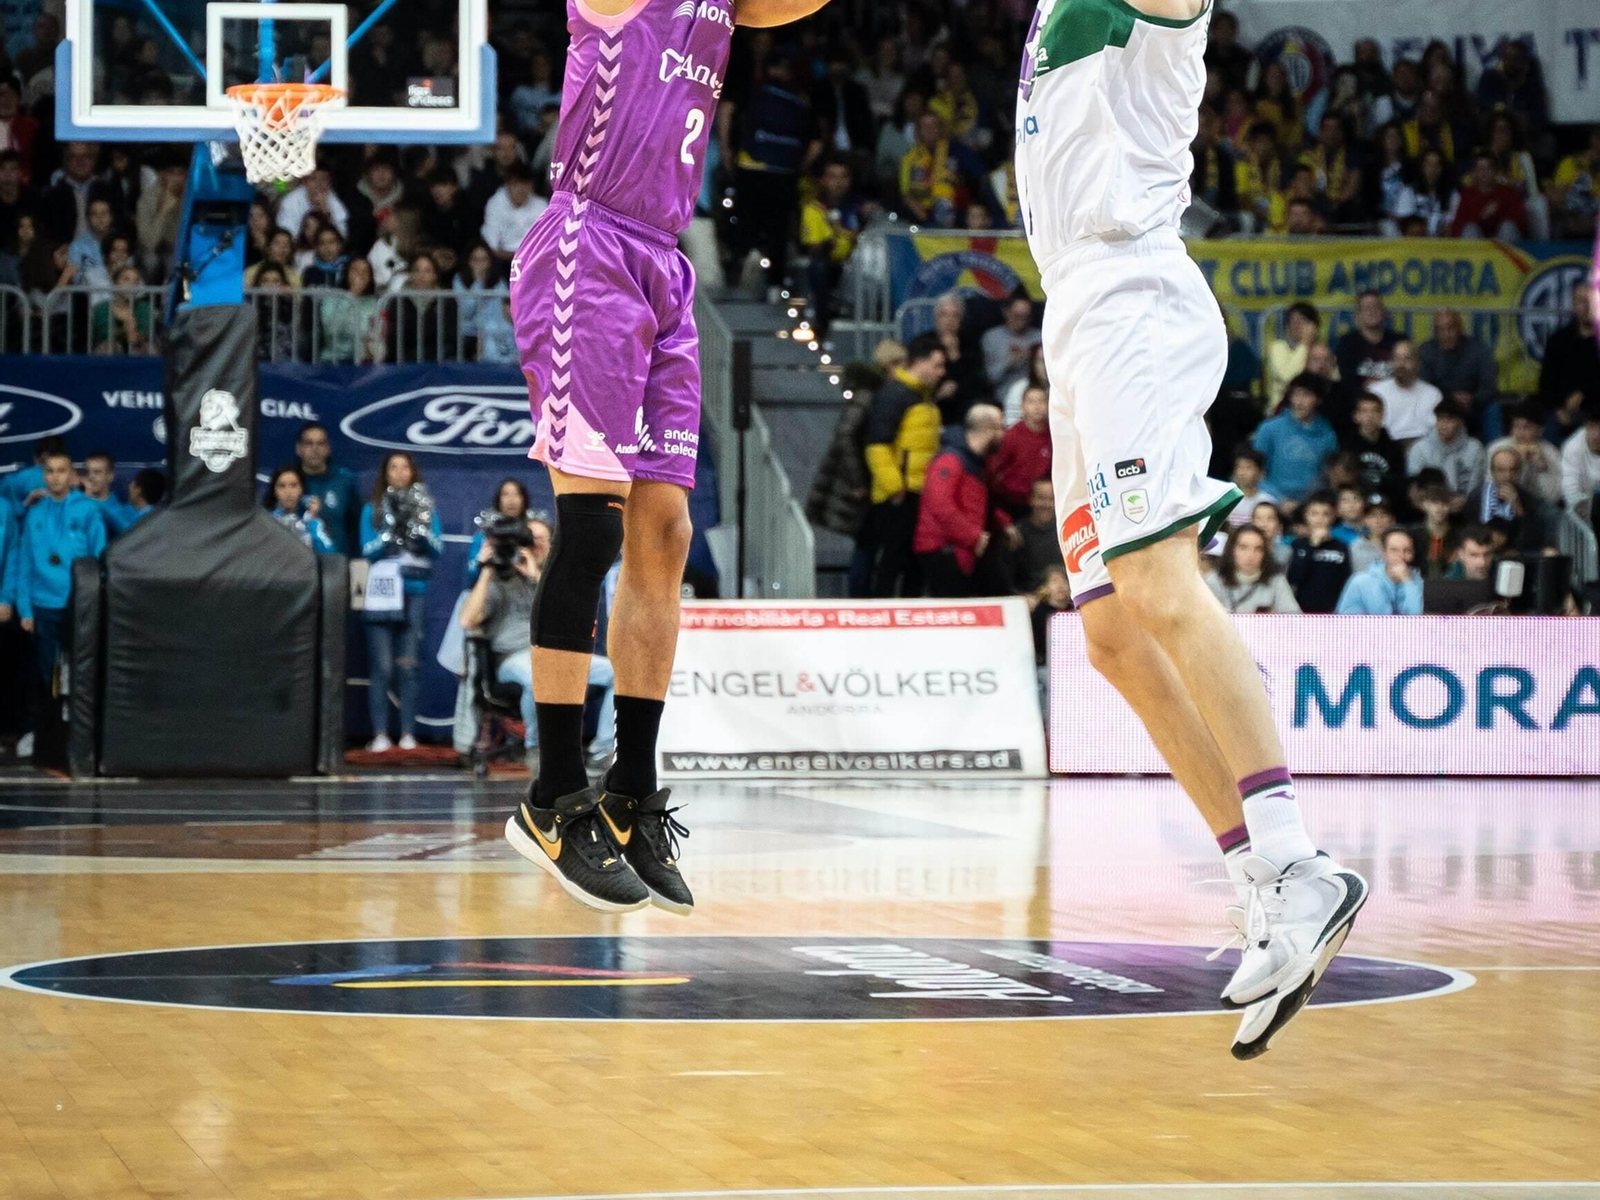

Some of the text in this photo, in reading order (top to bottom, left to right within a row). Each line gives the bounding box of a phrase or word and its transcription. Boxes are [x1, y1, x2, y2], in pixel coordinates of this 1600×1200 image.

[680, 108, 705, 165] 2
[1229, 259, 1316, 297] CLUB
[1327, 258, 1501, 297] ANDORRA
[102, 391, 319, 421] VEHI CIAL
[406, 394, 537, 446] For
[1117, 465, 1140, 477] acb
[838, 607, 891, 626] Real
[895, 605, 977, 625] Estate
[1293, 663, 1600, 731] MORA
